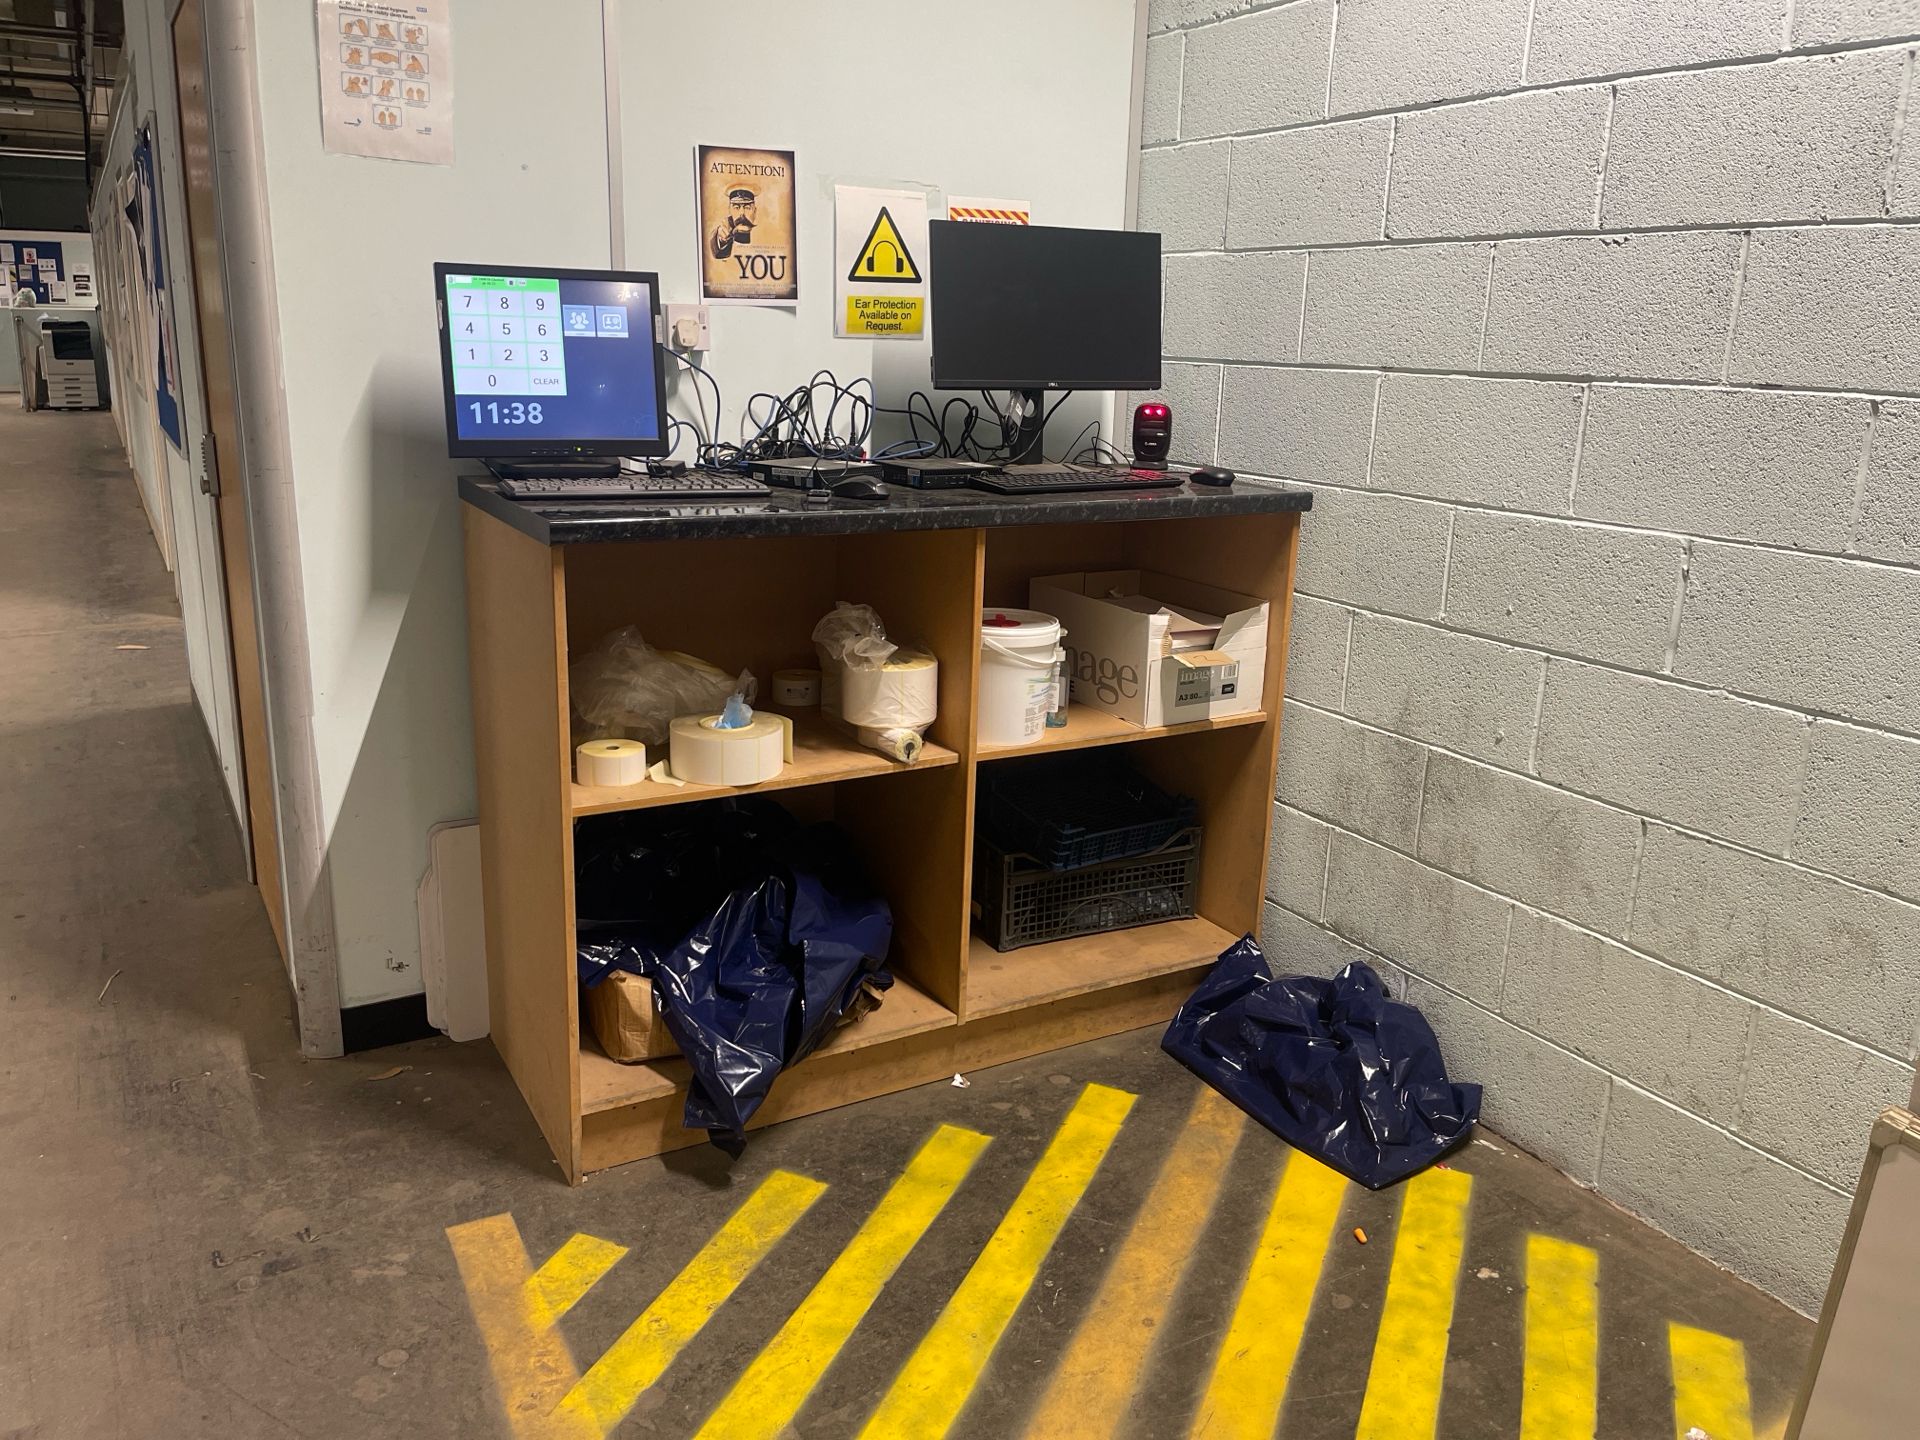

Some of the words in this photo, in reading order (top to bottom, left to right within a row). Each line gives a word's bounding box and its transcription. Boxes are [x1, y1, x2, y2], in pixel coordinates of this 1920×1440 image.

[710, 162, 785, 177] ATTENTION!
[734, 255, 787, 280] YOU
[463, 296, 472, 308] 7
[500, 297, 509, 309] 8
[536, 298, 545, 311] 9
[855, 299, 871, 309] Ear
[873, 299, 916, 310] Protection
[859, 310, 899, 320] Available
[901, 312, 912, 320] on
[465, 322, 474, 334] 4
[502, 323, 511, 335] 5
[538, 324, 547, 336] 6
[865, 321, 903, 332] Request.
[468, 348, 475, 360] 1
[504, 349, 513, 361] 2
[540, 350, 549, 362] 3
[488, 375, 497, 387] 0
[470, 402, 544, 425] 11:38
